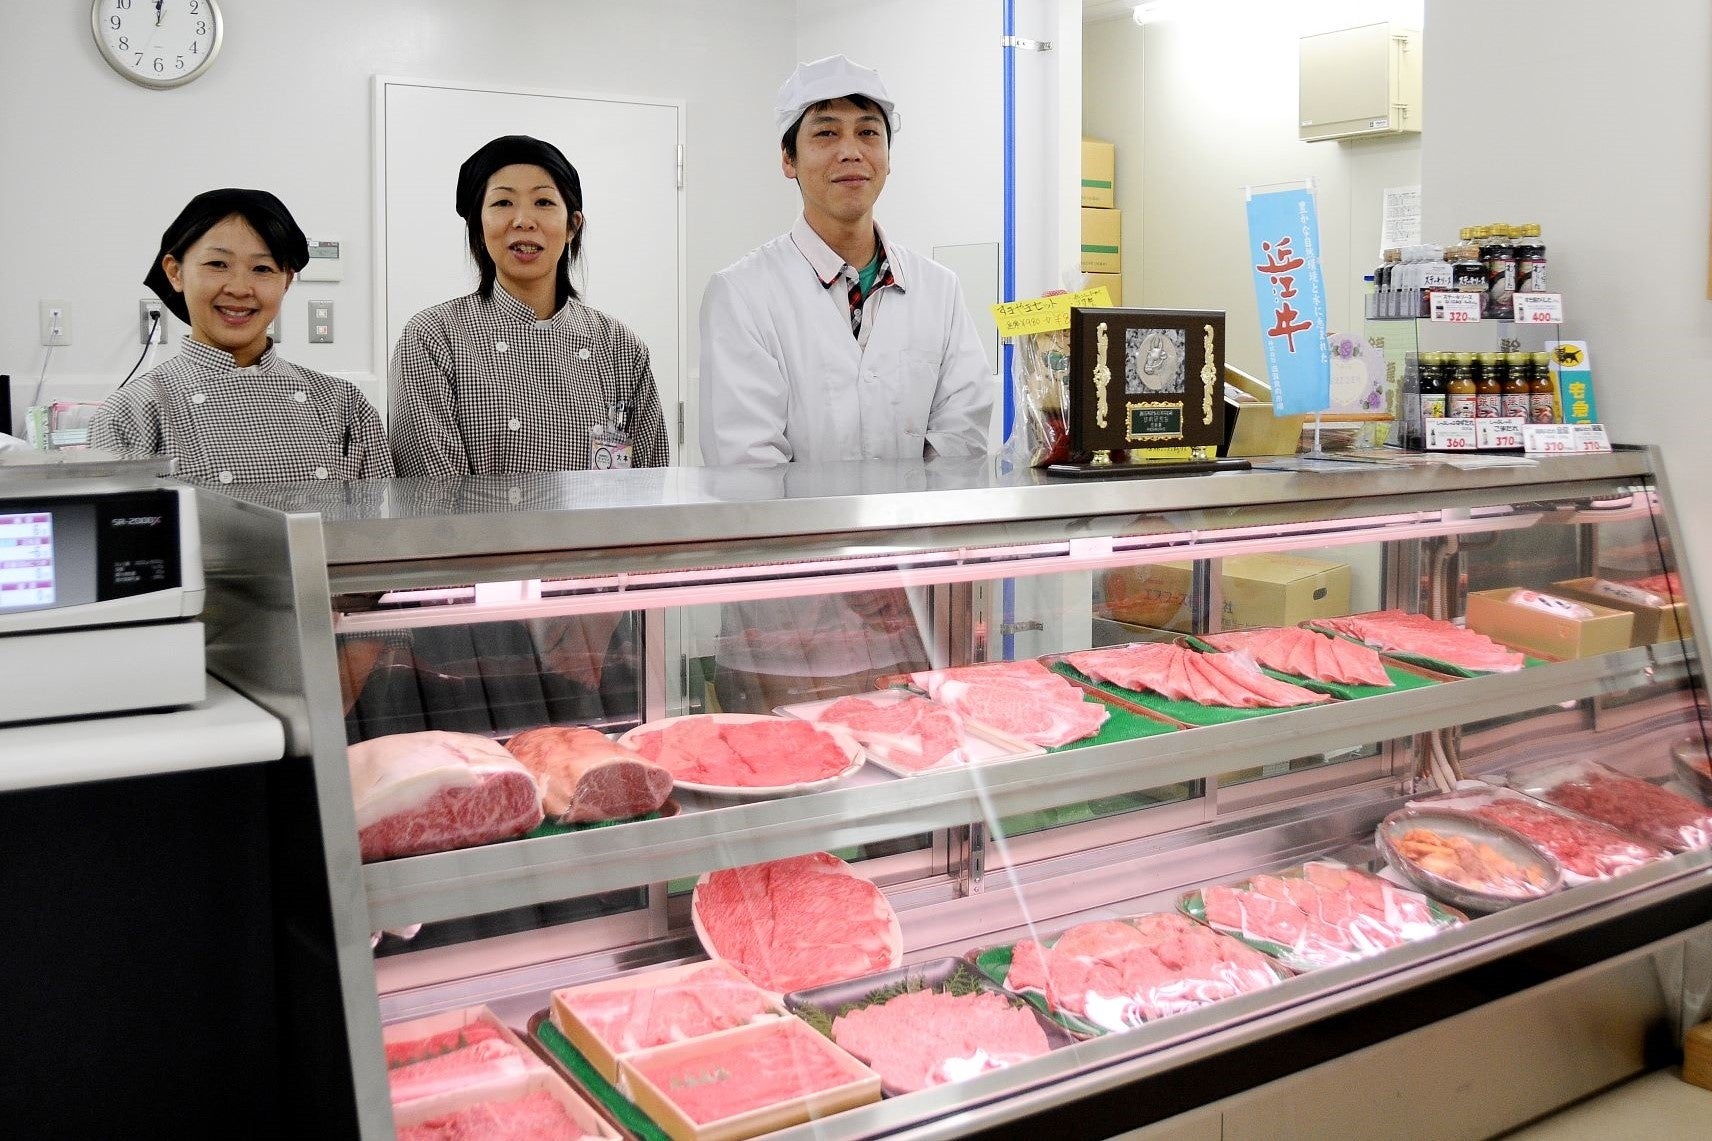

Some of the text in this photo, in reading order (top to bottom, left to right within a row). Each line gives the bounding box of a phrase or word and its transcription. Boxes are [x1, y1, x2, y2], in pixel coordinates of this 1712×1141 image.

[189, 0, 199, 14] 2
[110, 15, 121, 30] 9
[196, 21, 206, 35] 3
[118, 36, 129, 50] 8
[189, 41, 198, 53] 4
[134, 52, 144, 66] 7
[153, 57, 164, 72] 6
[175, 55, 184, 69] 5
[1255, 235, 1313, 354] 近江牛
[1449, 311, 1468, 321] 320
[1532, 312, 1551, 321] 400
[1568, 381, 1591, 424] 宅急
[1446, 438, 1465, 448] 360
[1496, 436, 1515, 446] 370
[1545, 442, 1564, 451] 370
[1584, 442, 1600, 450] 370
